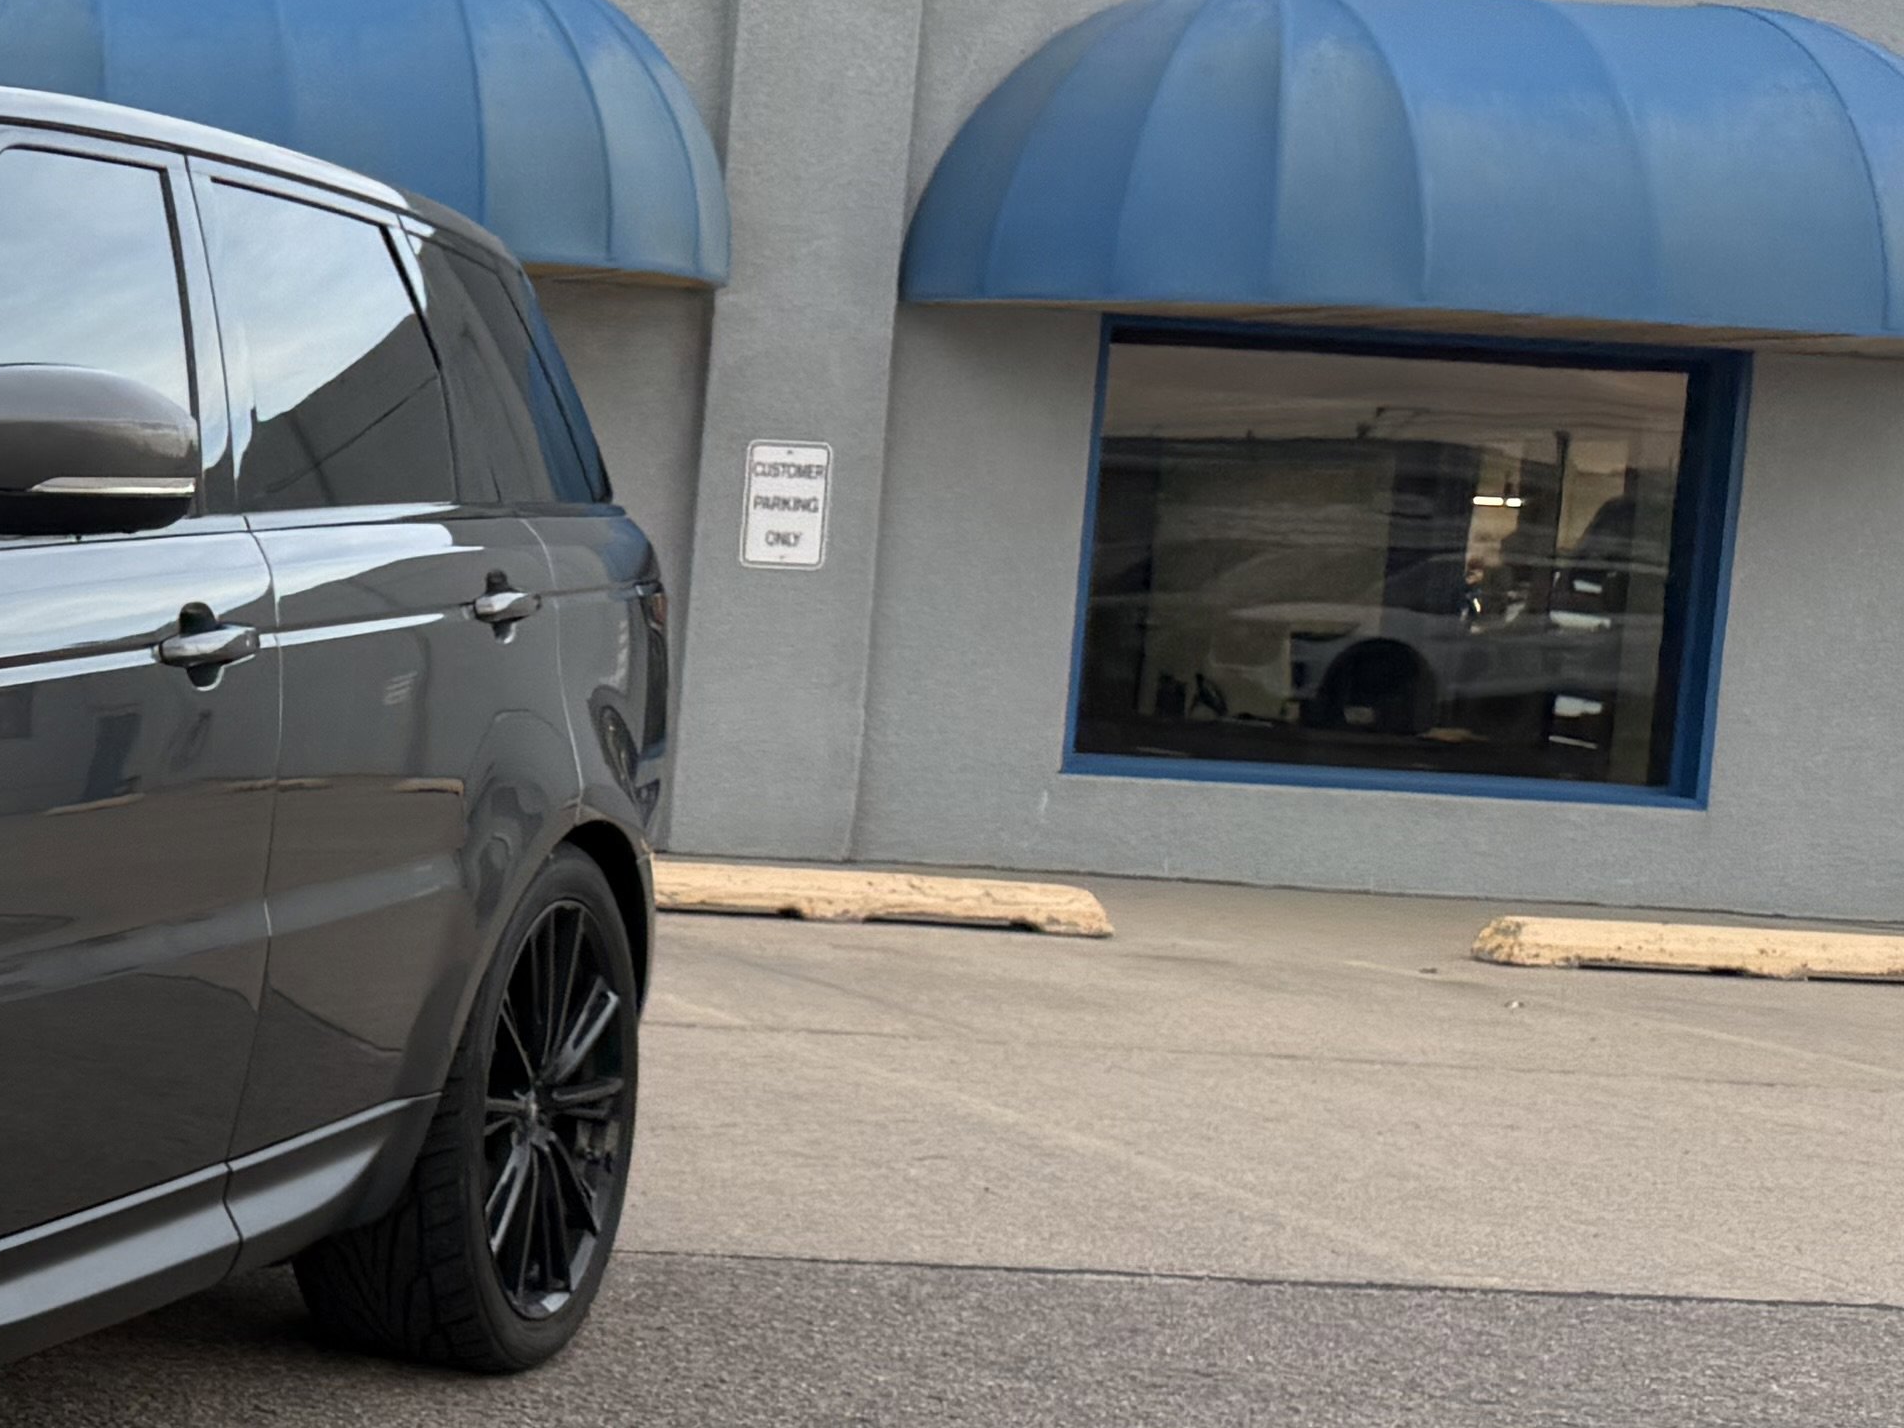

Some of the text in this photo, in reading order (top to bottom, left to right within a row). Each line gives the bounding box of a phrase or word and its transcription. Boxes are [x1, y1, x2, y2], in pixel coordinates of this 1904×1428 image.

[753, 461, 824, 479] CUSTOMER
[753, 495, 819, 513] PARKING
[765, 530, 801, 547] ONLY
